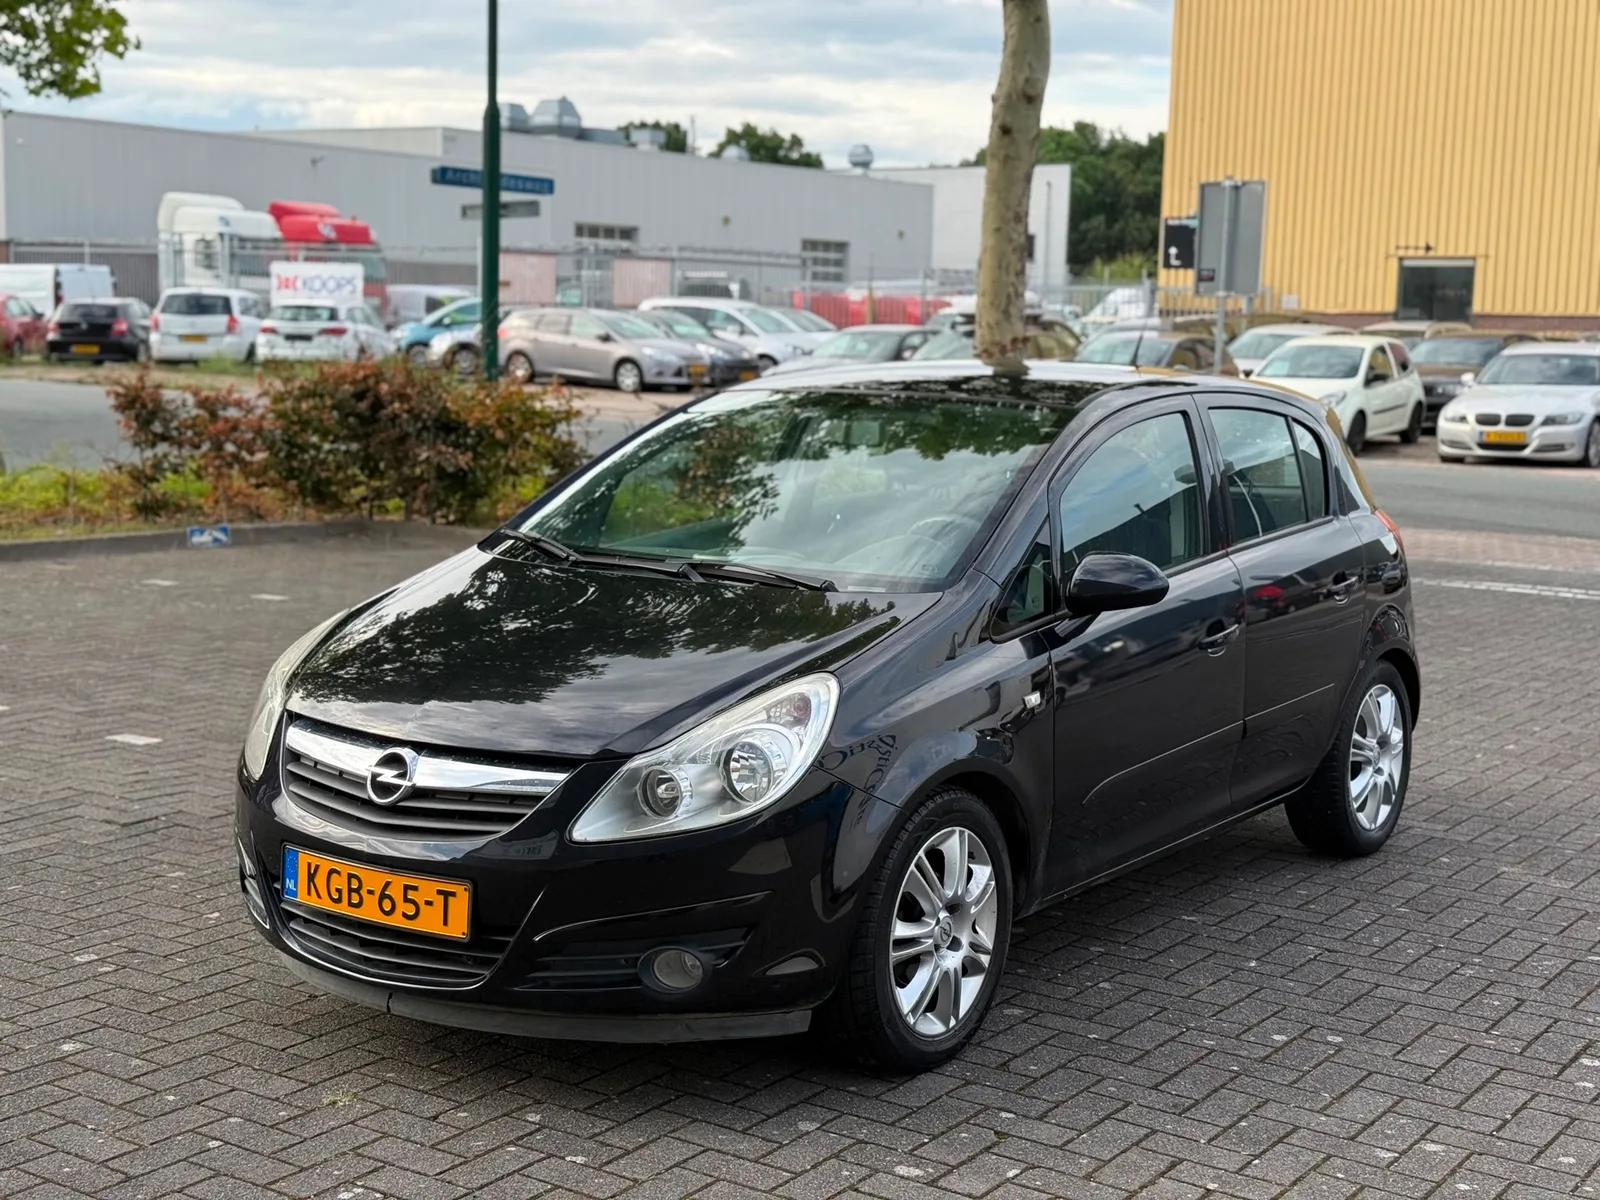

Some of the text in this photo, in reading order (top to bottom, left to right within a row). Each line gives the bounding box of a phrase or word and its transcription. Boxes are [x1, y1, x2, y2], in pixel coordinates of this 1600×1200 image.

[302, 275, 357, 294] KOOPS
[285, 878, 297, 891] NL
[306, 861, 457, 927] KGB-65-T
